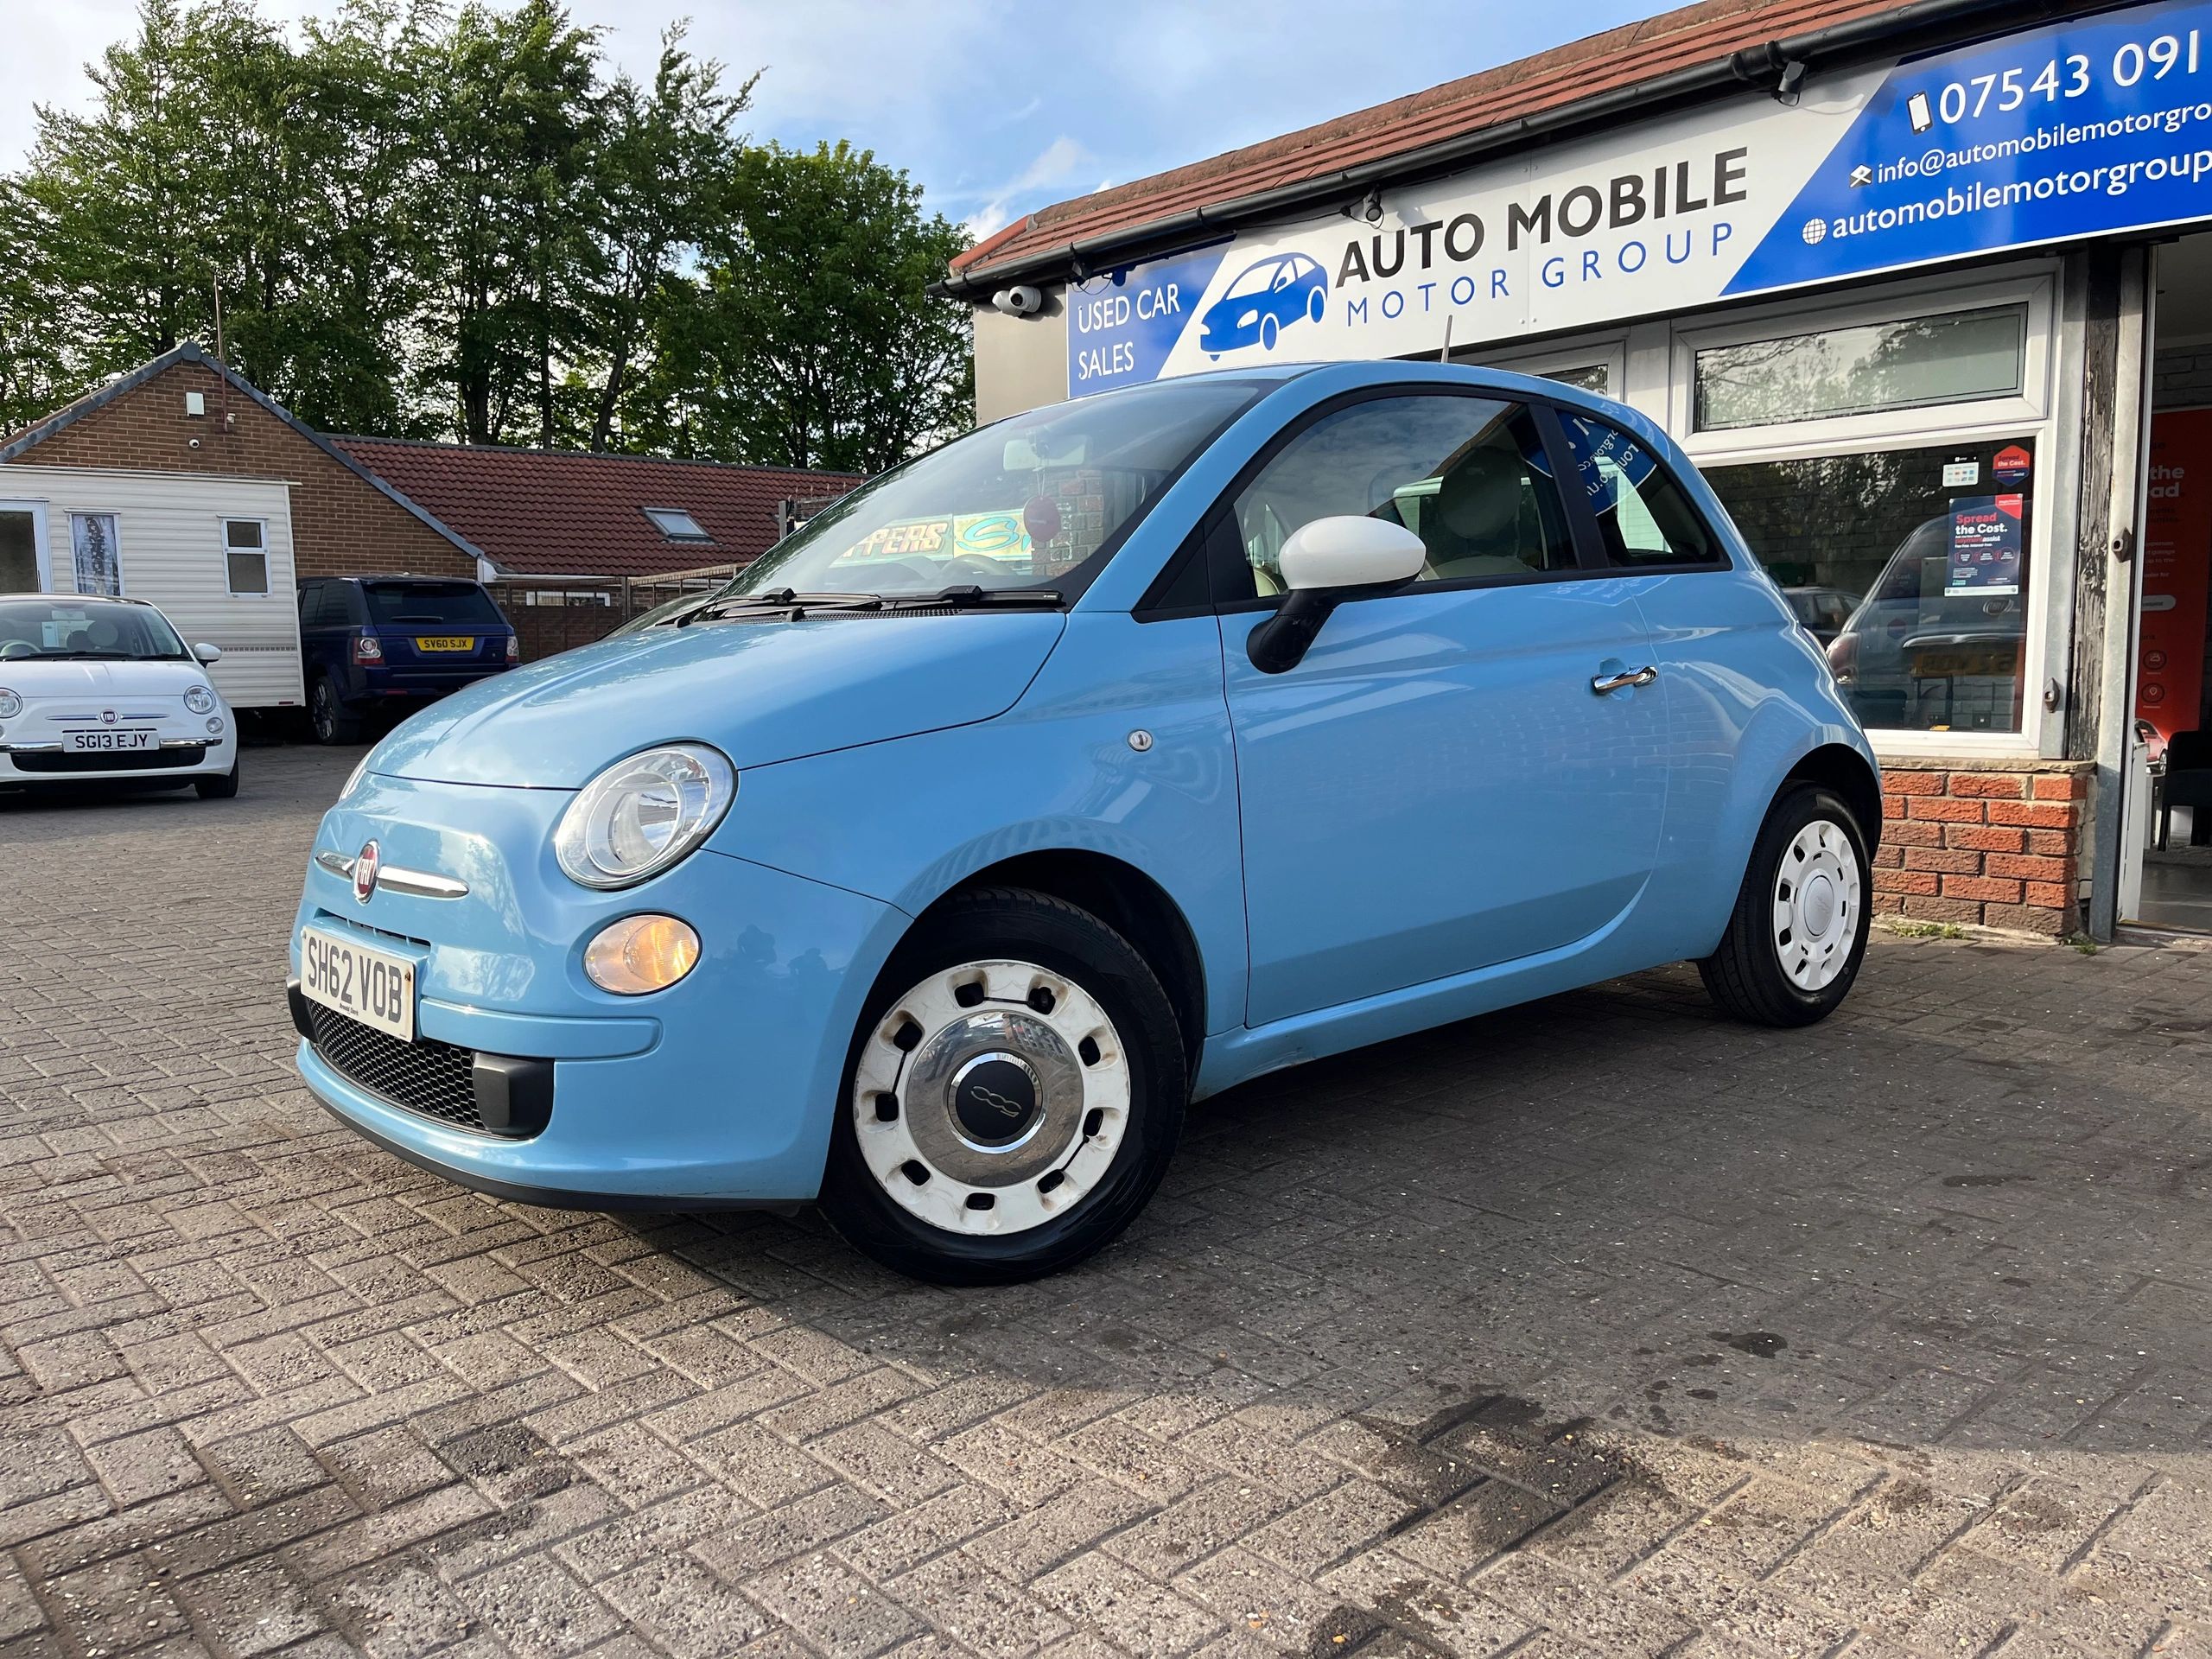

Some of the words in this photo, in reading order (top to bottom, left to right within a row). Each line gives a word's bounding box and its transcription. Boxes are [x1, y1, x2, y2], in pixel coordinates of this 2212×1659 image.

[1939, 54, 2089, 124] 07543
[2113, 29, 2199, 87] 091
[1878, 103, 2212, 184] info@automobilemotorgro
[1335, 213, 1485, 289] AUTO
[1508, 146, 1748, 252] MOBILE
[1832, 150, 2212, 238] automobilemotorgroup
[1347, 269, 1510, 327] MOTOR
[1541, 222, 1732, 289] GROUP
[1078, 296, 1130, 334] USED
[1136, 283, 1181, 321] CAR
[1078, 341, 1135, 380] SALES
[2150, 465, 2184, 480] the
[1955, 524, 1975, 535] the
[1977, 522, 2008, 534] Cost.
[1956, 512, 1998, 525] Spread
[424, 639, 448, 649] SV60
[450, 639, 467, 649] SJX
[75, 734, 112, 749] SG13
[117, 734, 148, 748] EJY
[308, 936, 353, 1004] SH62
[359, 955, 403, 1023] VOB
